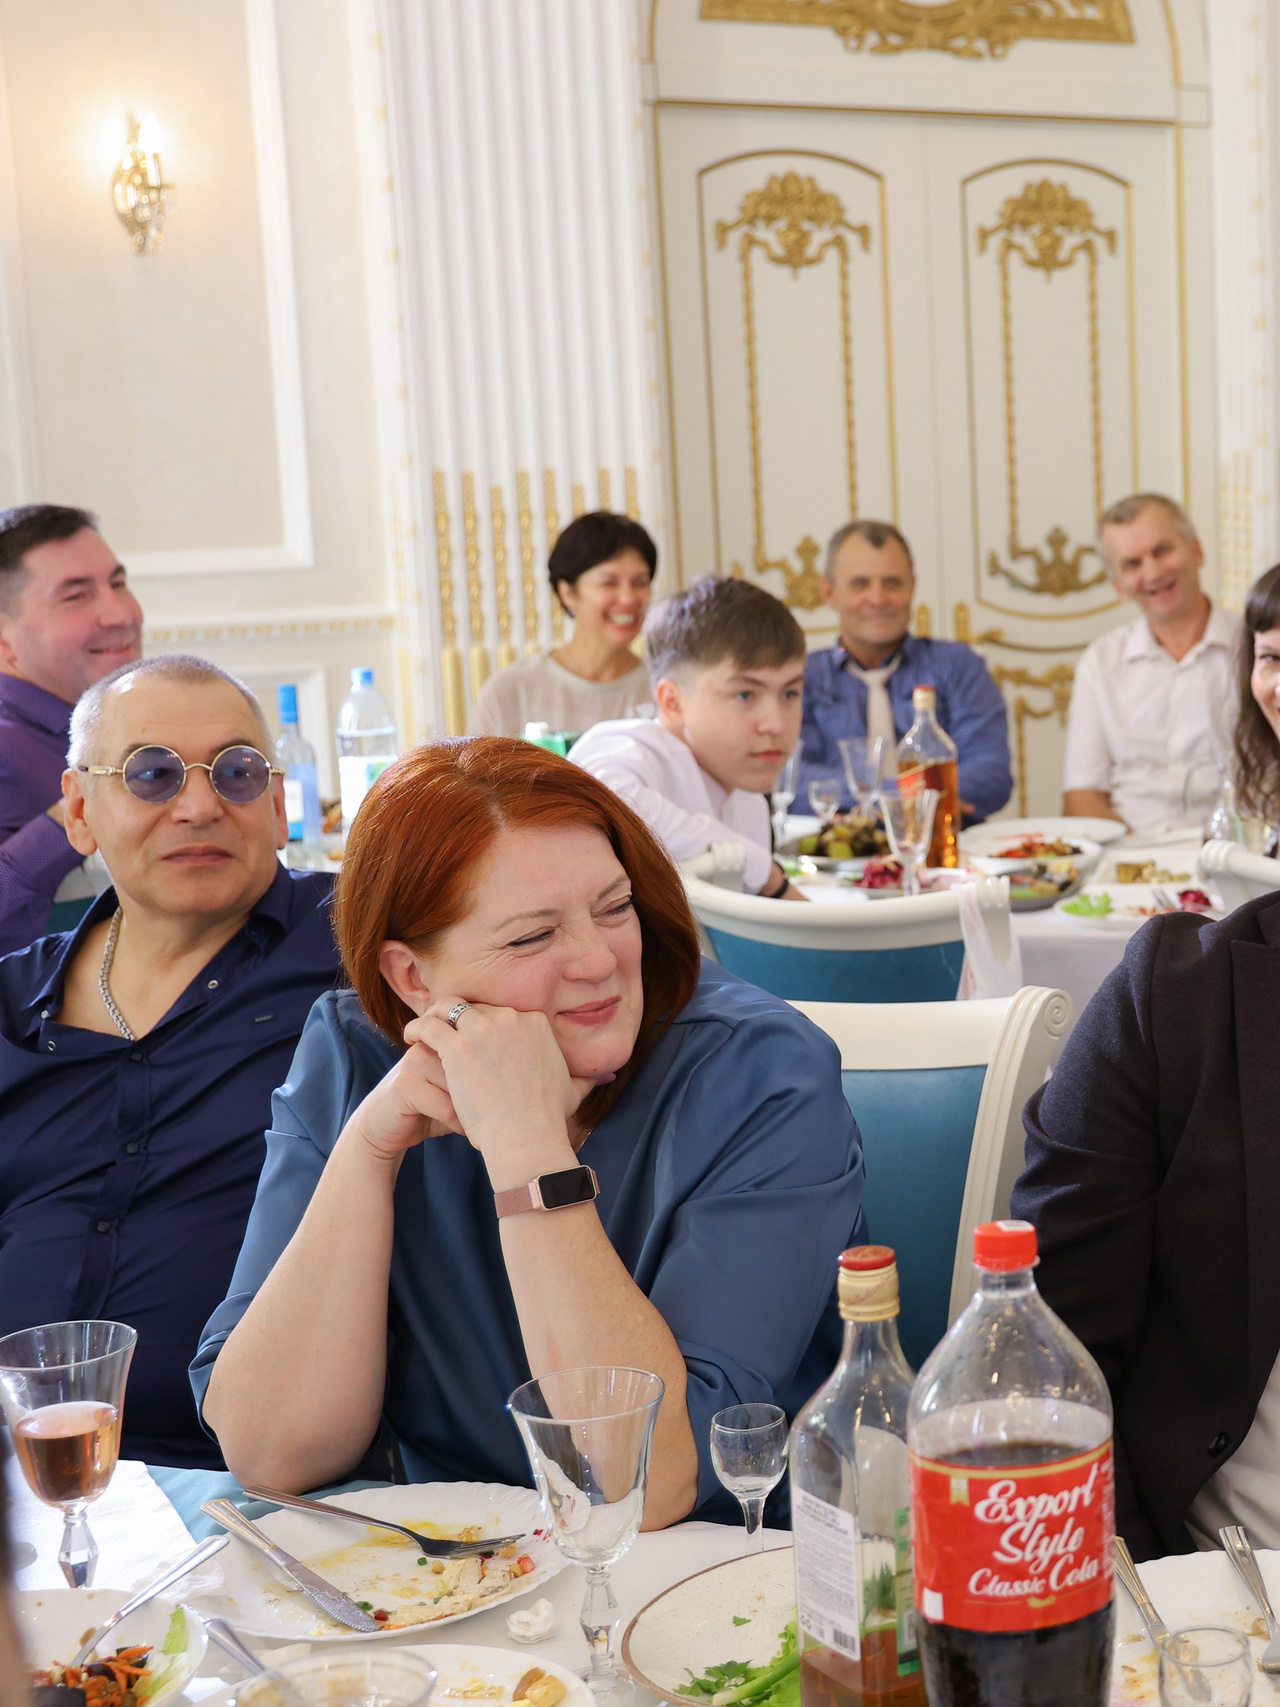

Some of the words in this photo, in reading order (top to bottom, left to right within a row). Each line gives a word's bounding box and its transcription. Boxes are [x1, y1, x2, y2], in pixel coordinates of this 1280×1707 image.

[974, 1462, 1099, 1542] Export
[992, 1517, 1085, 1574] Style
[968, 1567, 1047, 1597] Classic
[1049, 1553, 1099, 1591] Cola
